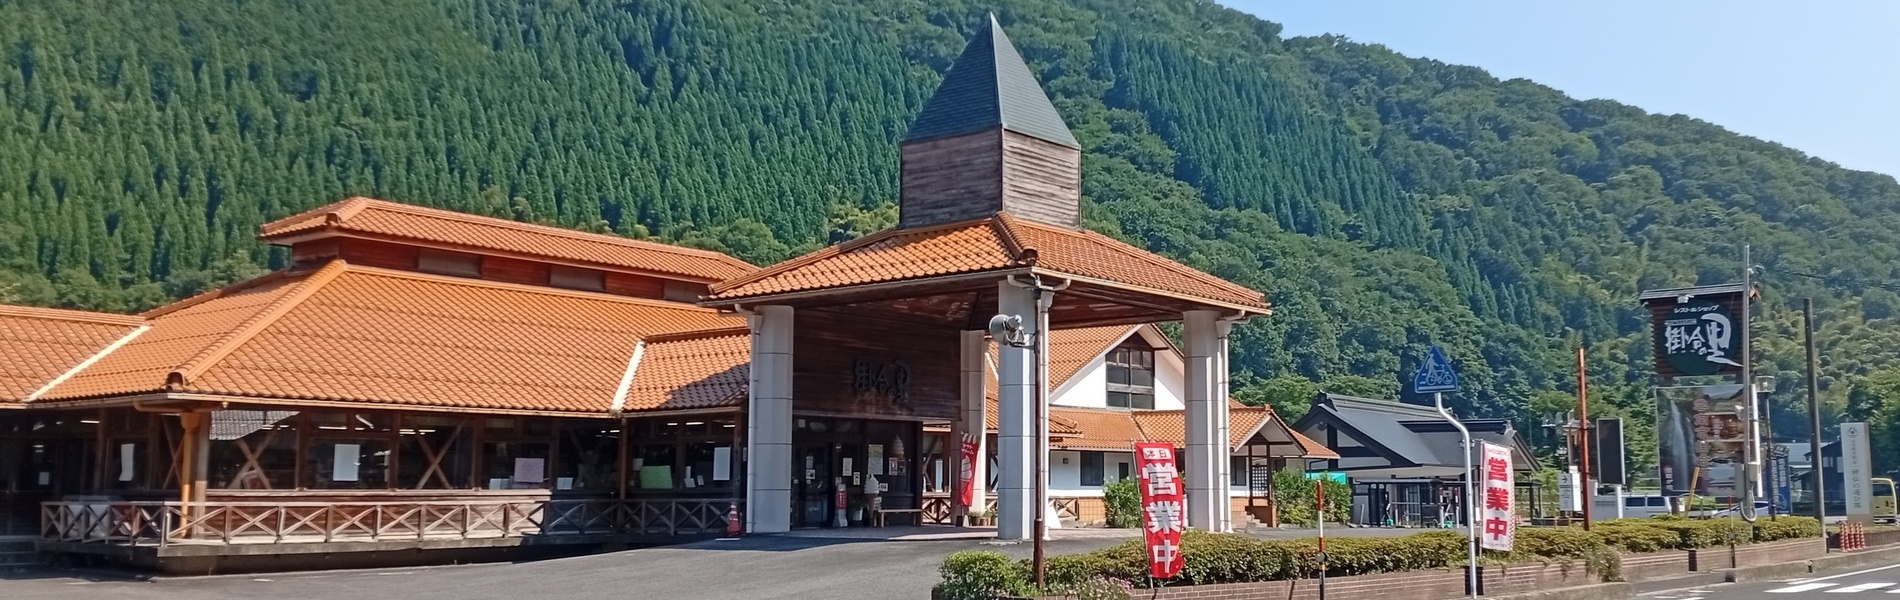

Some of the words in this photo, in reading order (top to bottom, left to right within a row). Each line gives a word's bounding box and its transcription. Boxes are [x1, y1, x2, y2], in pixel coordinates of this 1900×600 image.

[1665, 313, 1743, 367] 掛合の里
[1145, 449, 1168, 458] 本日
[1141, 462, 1182, 573] 営業中
[1486, 457, 1509, 541] 営業中
